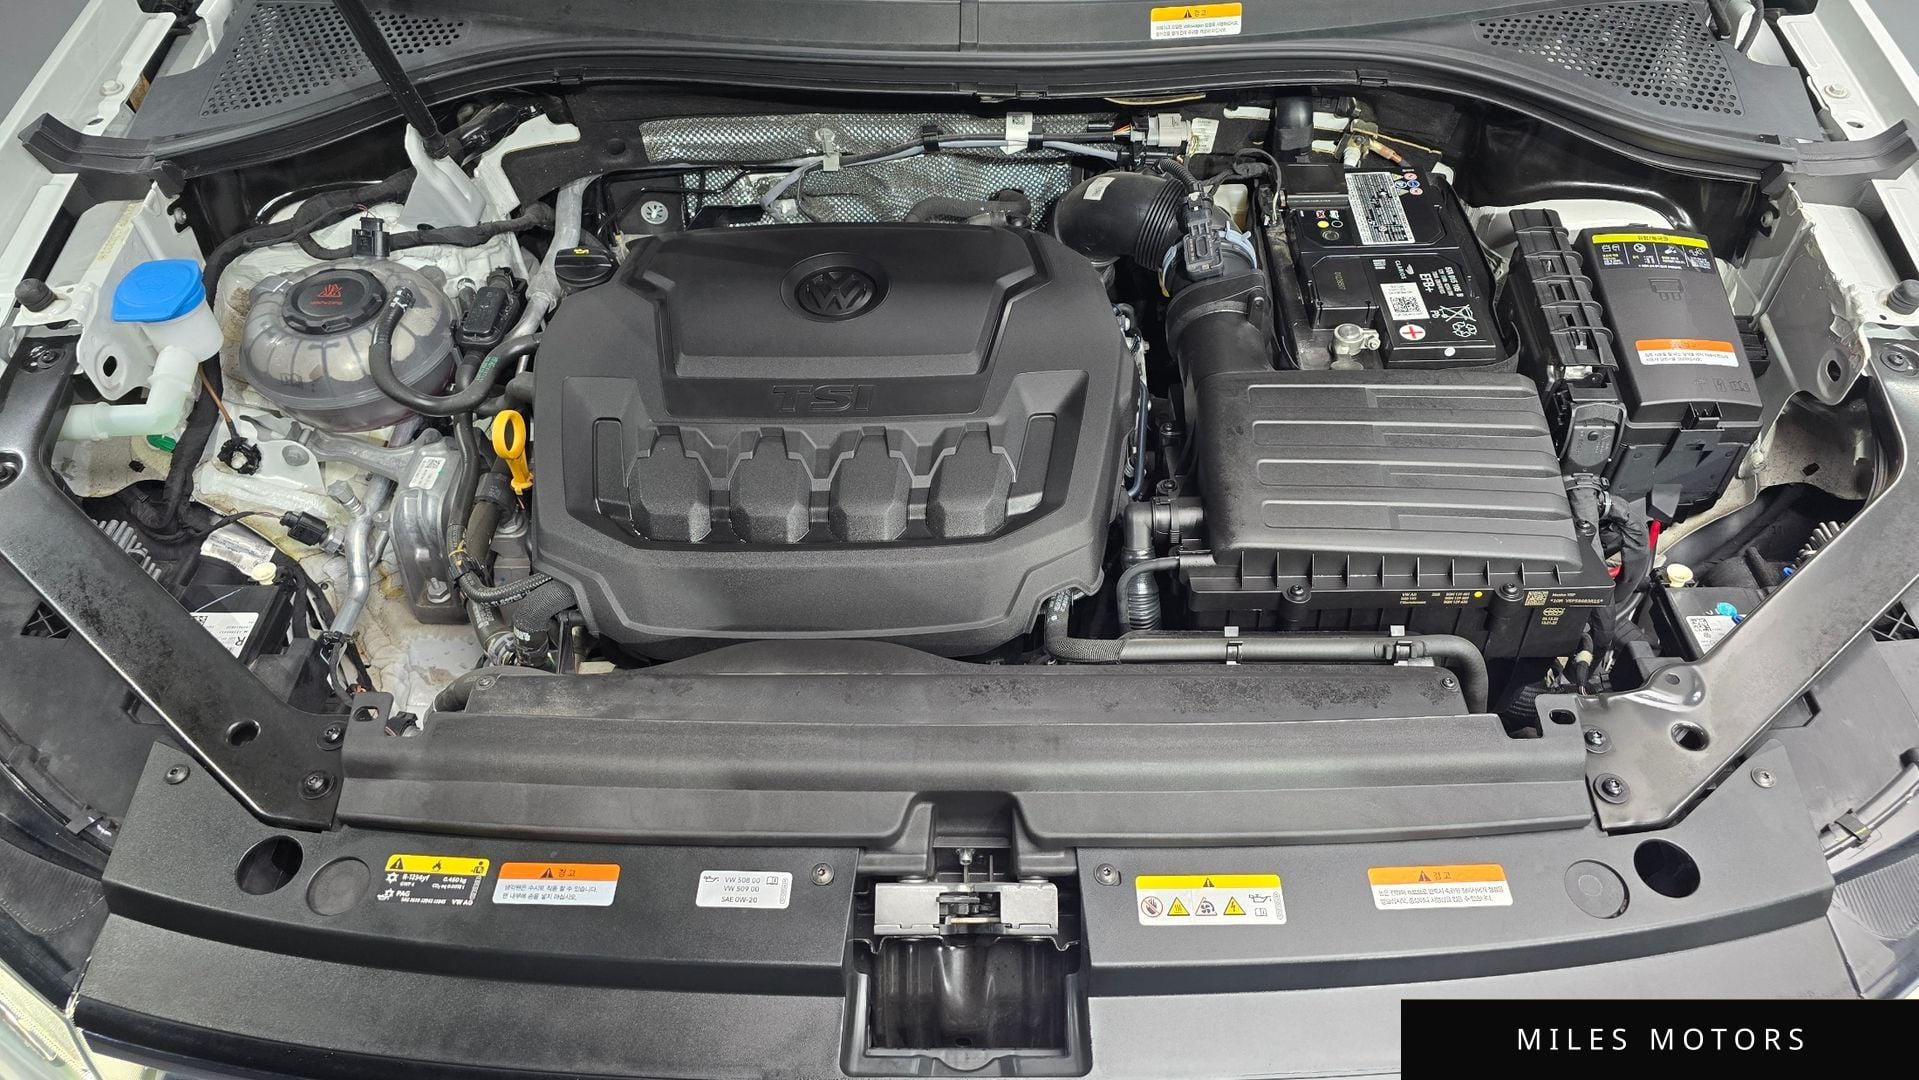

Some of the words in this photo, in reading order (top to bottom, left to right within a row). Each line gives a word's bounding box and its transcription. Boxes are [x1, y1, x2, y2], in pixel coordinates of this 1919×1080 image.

[1419, 273, 1435, 293] EFB+
[773, 384, 875, 412] TSI
[402, 873, 430, 882] R-1234yf
